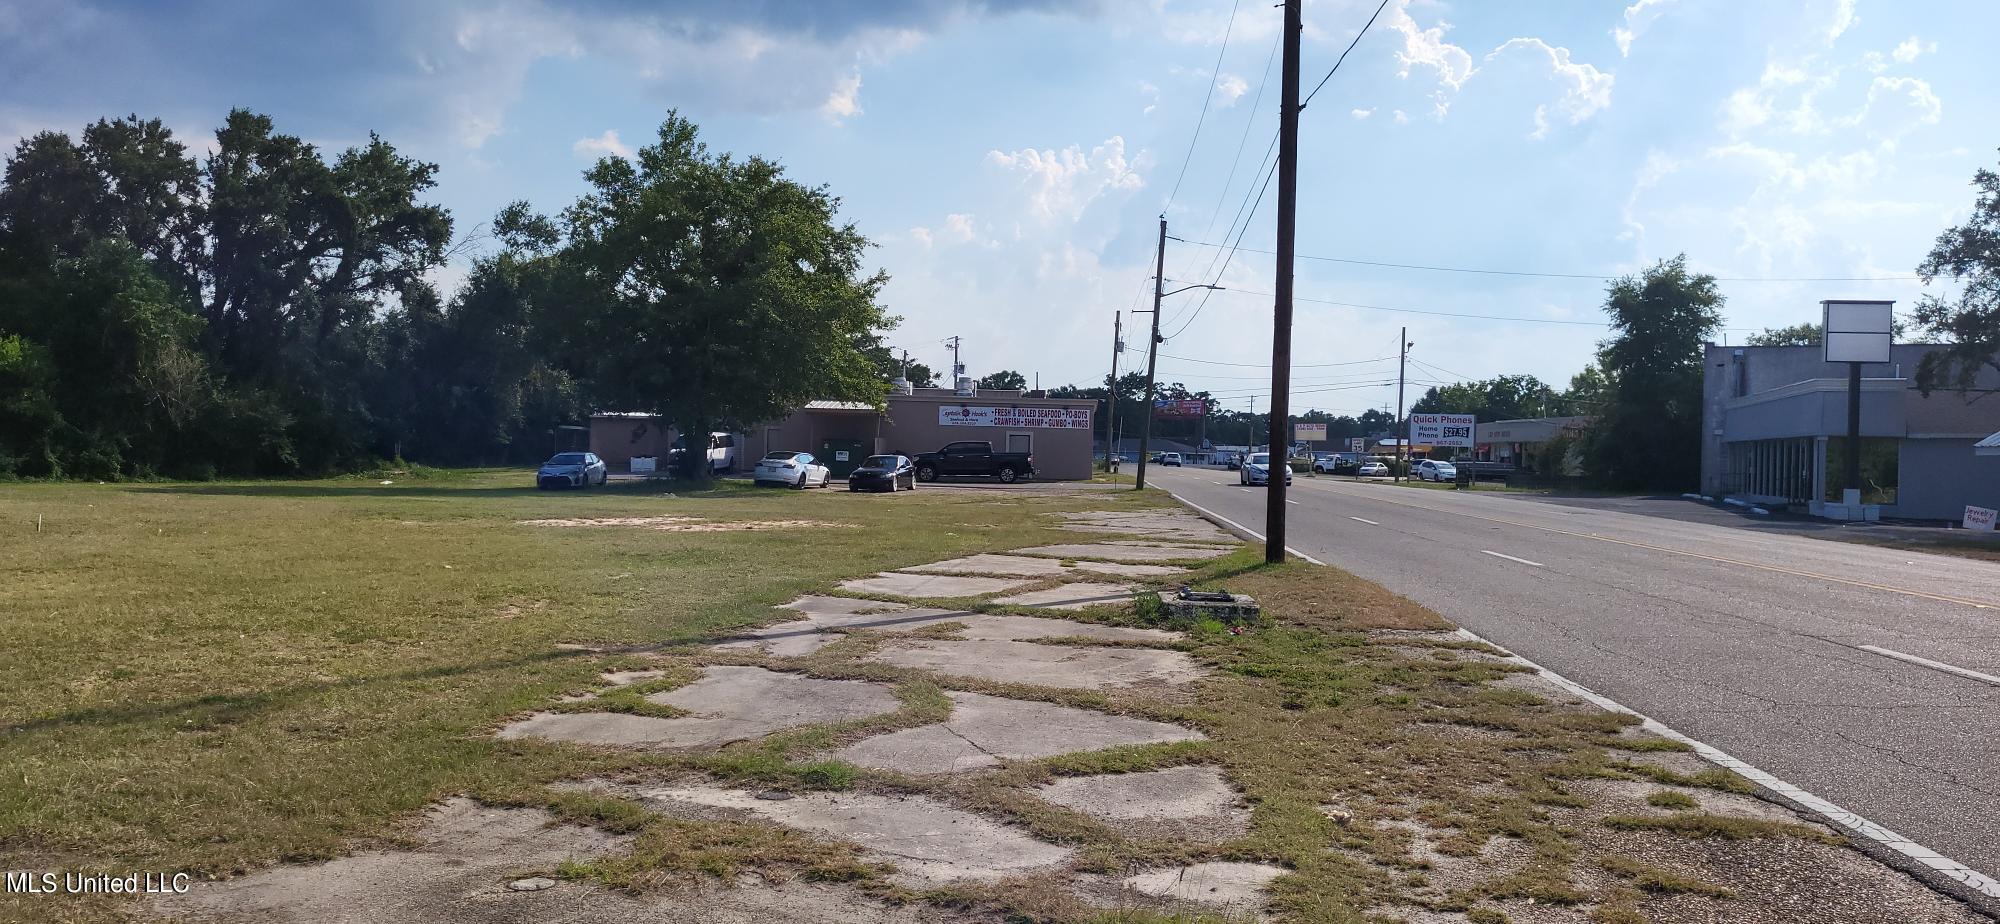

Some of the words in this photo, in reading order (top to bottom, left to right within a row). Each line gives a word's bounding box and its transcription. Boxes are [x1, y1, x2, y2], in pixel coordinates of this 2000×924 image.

[994, 408, 1011, 417] FRESH
[1018, 409, 1037, 418] BOILED
[1037, 409, 1061, 418] SEAFOOD
[1065, 410, 1088, 419] PO-BOYS
[993, 417, 1020, 426] CRAWFISH
[1024, 418, 1044, 427] SHRIMP
[1048, 418, 1067, 427] GUMBO
[1071, 419, 1089, 428] WINGS
[1413, 415, 1438, 425] Quick
[1440, 415, 1473, 424] Phones
[1444, 427, 1467, 437] $27.95
